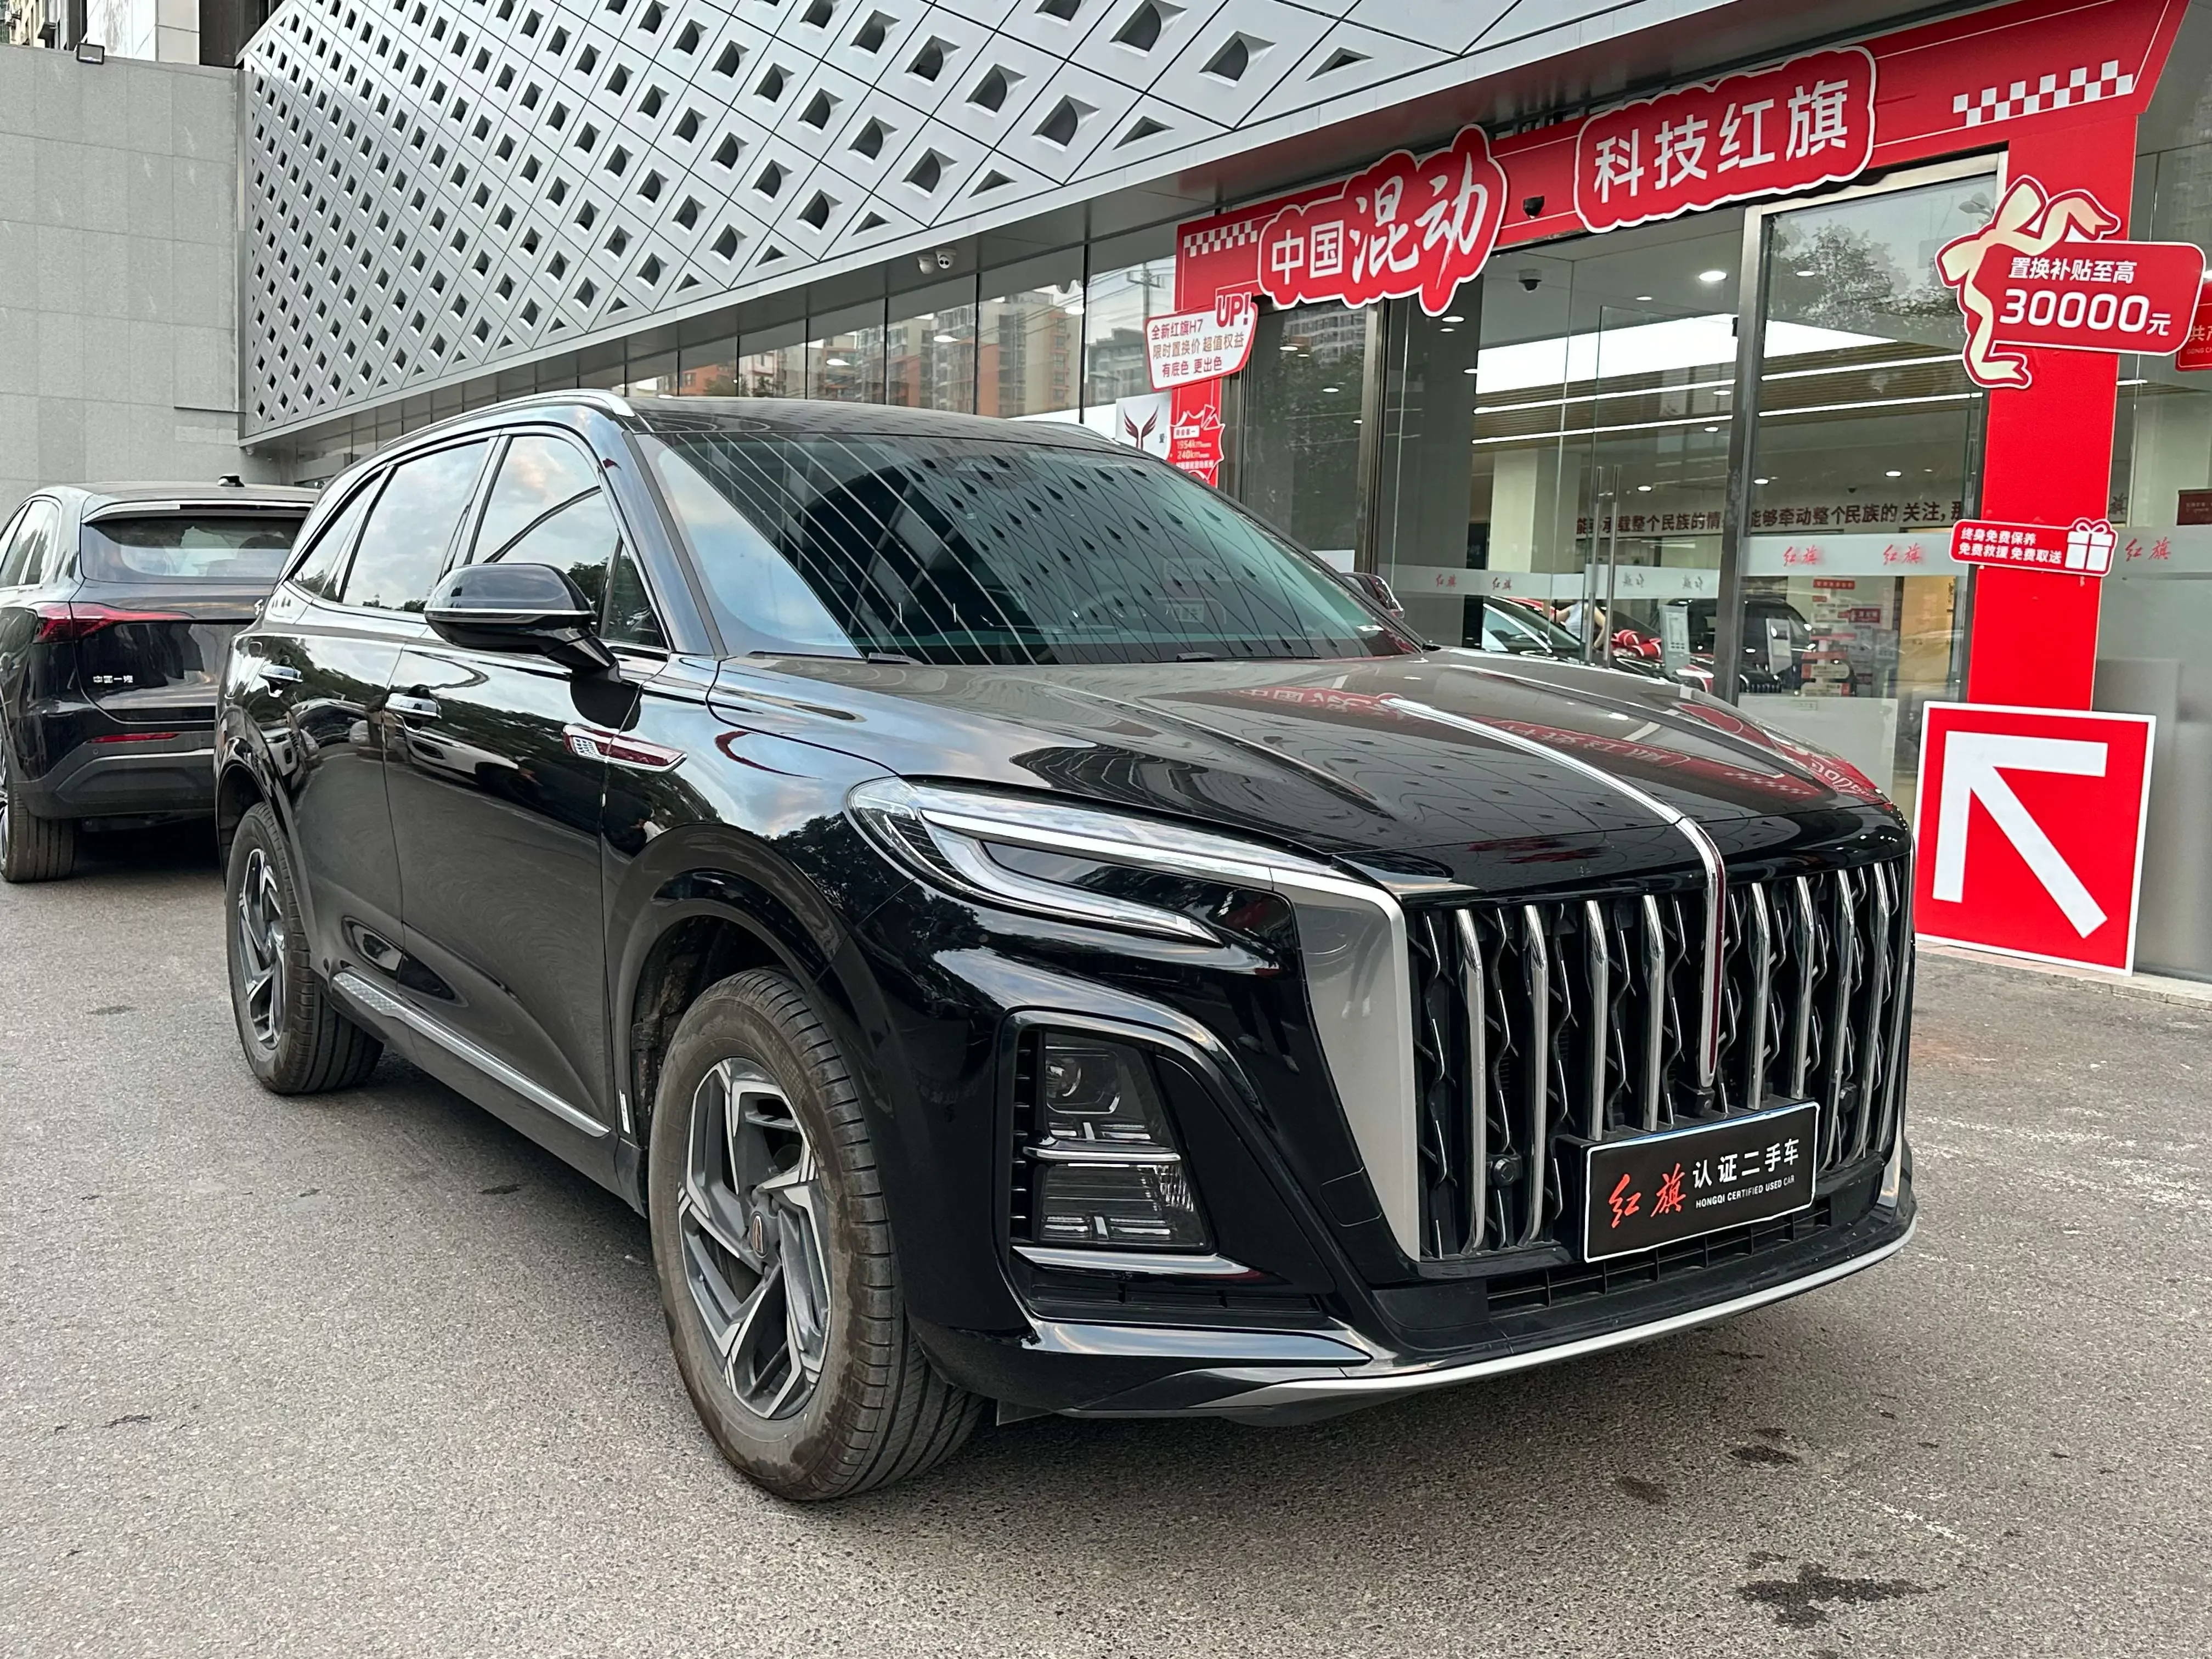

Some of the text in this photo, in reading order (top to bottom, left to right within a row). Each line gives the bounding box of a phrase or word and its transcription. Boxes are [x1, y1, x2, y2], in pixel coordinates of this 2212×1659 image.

[1594, 79, 1849, 204] 科技红旗
[1271, 151, 1488, 289] 中国混动
[2008, 257, 2137, 285] 置换补贴至高
[1216, 294, 1250, 328] UP!
[1999, 289, 2171, 337] 30000元
[1151, 318, 1204, 340] 全新红旗H7
[1153, 331, 1244, 359] 限时置换价 超值权益
[1162, 357, 1222, 377] 有底色 更出色
[1960, 527, 2036, 545] 终身免费保养
[2125, 537, 2171, 562] 红旗
[1784, 544, 1818, 567] 红旗
[1883, 542, 1922, 566] 红旗
[1958, 542, 2062, 565] 免费救援 免费取送
[1609, 1138, 1799, 1228] 红旗 认证二手车
[1696, 1175, 1795, 1209] HONGQI CERTIFIED USED CAR
